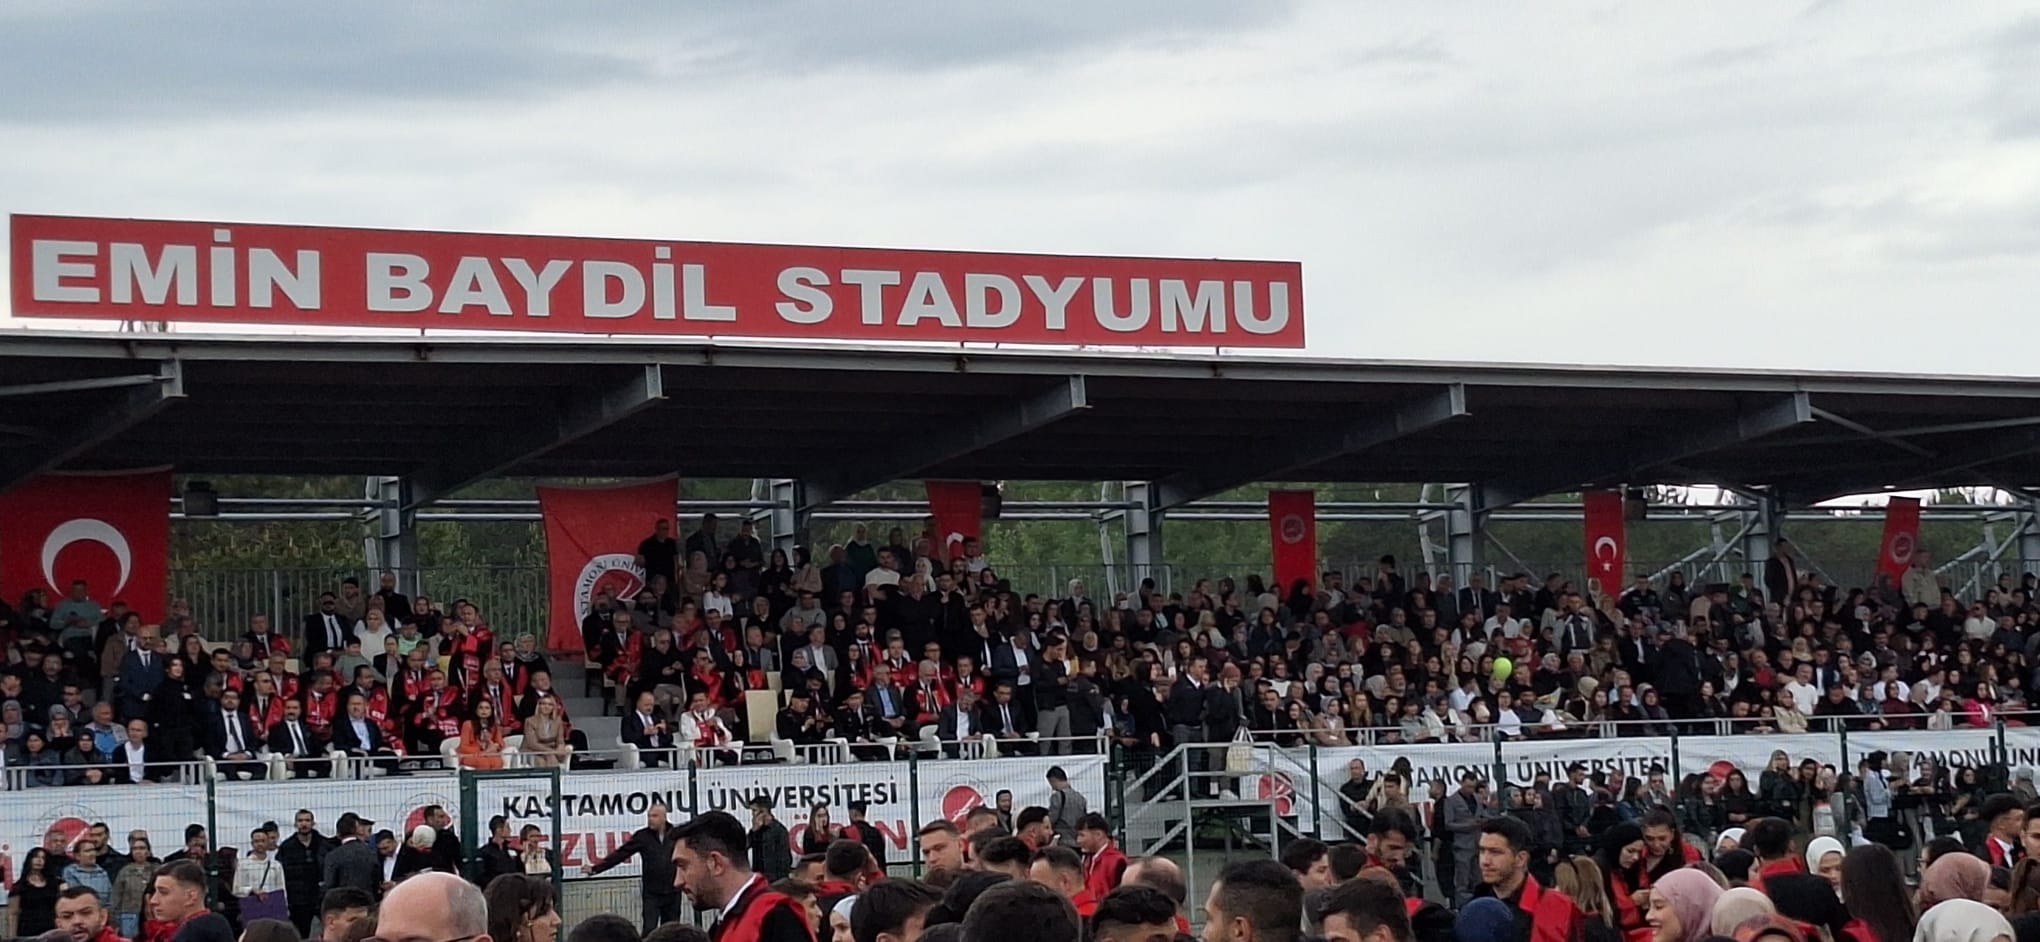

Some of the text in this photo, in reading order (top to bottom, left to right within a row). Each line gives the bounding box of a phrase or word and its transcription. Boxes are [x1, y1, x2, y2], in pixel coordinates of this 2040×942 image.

[31, 228, 1289, 334] EMİN BAYDİL STADYUMU
[707, 774, 898, 812] ÜNİVERSİTESİ
